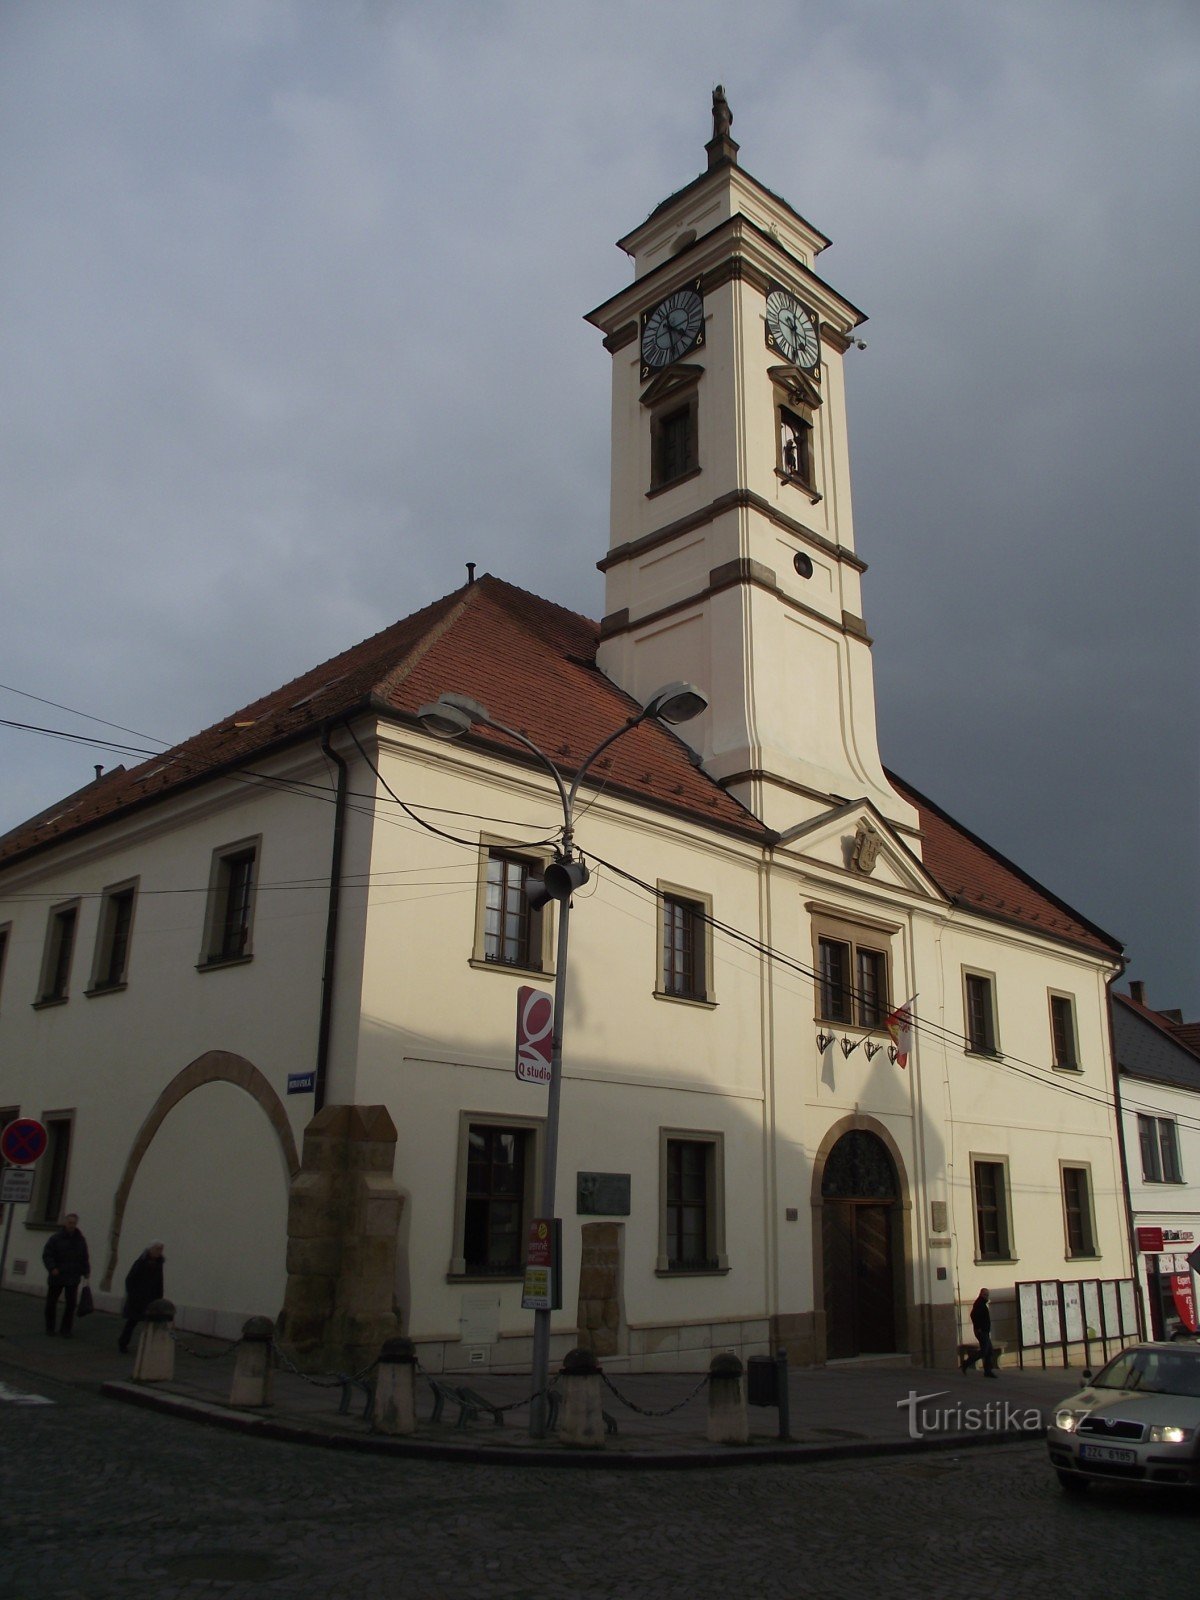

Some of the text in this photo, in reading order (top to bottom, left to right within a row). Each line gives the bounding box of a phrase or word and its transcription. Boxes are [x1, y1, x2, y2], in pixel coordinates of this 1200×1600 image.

[696, 333, 703, 344] 6
[768, 334, 774, 345] 5
[642, 367, 649, 378] 2
[518, 1062, 551, 1081] Q studio
